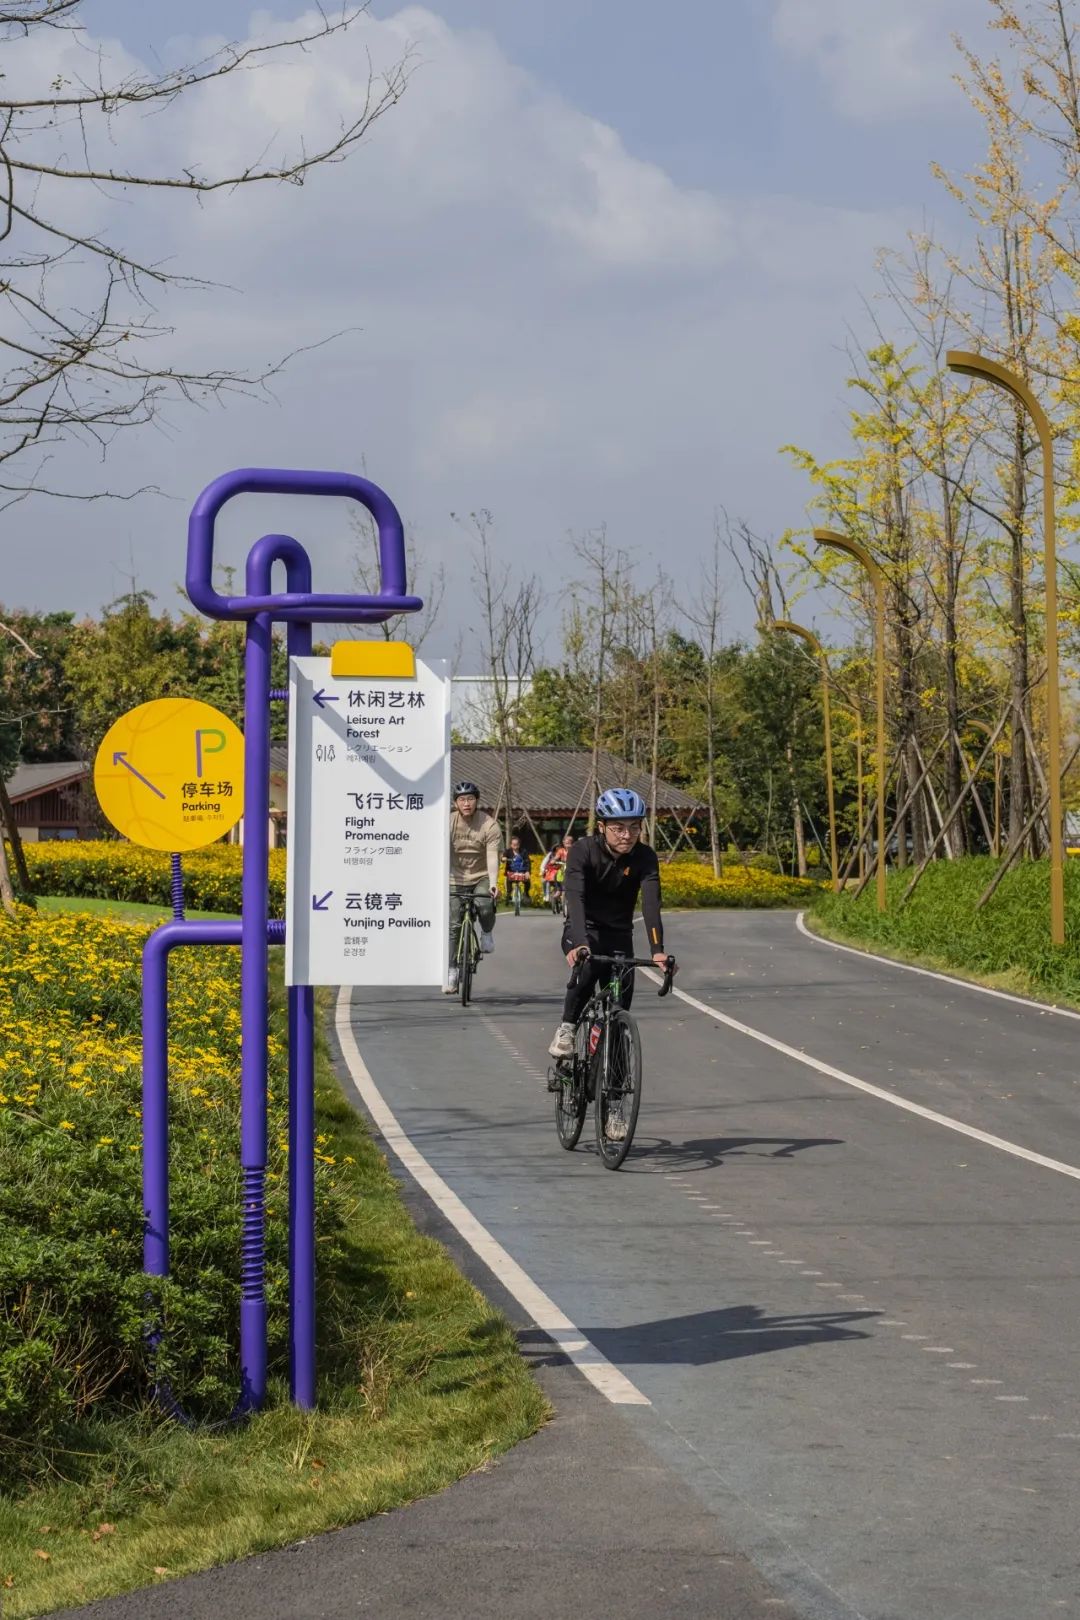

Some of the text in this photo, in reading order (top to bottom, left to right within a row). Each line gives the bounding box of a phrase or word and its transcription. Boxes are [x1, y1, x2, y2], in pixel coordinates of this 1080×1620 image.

[347, 690, 425, 708] 休闲艺林
[347, 715, 405, 725] Leisure Art
[346, 728, 380, 738] Forest
[195, 728, 227, 778] P
[181, 781, 233, 798] 停车场
[182, 801, 220, 812] Parking
[346, 792, 424, 810] 飞行长廊
[345, 817, 375, 829] Flight
[345, 830, 410, 840] Promenade
[345, 892, 403, 911] 云镜亭
[344, 917, 431, 930] Yunjing Pavilion
